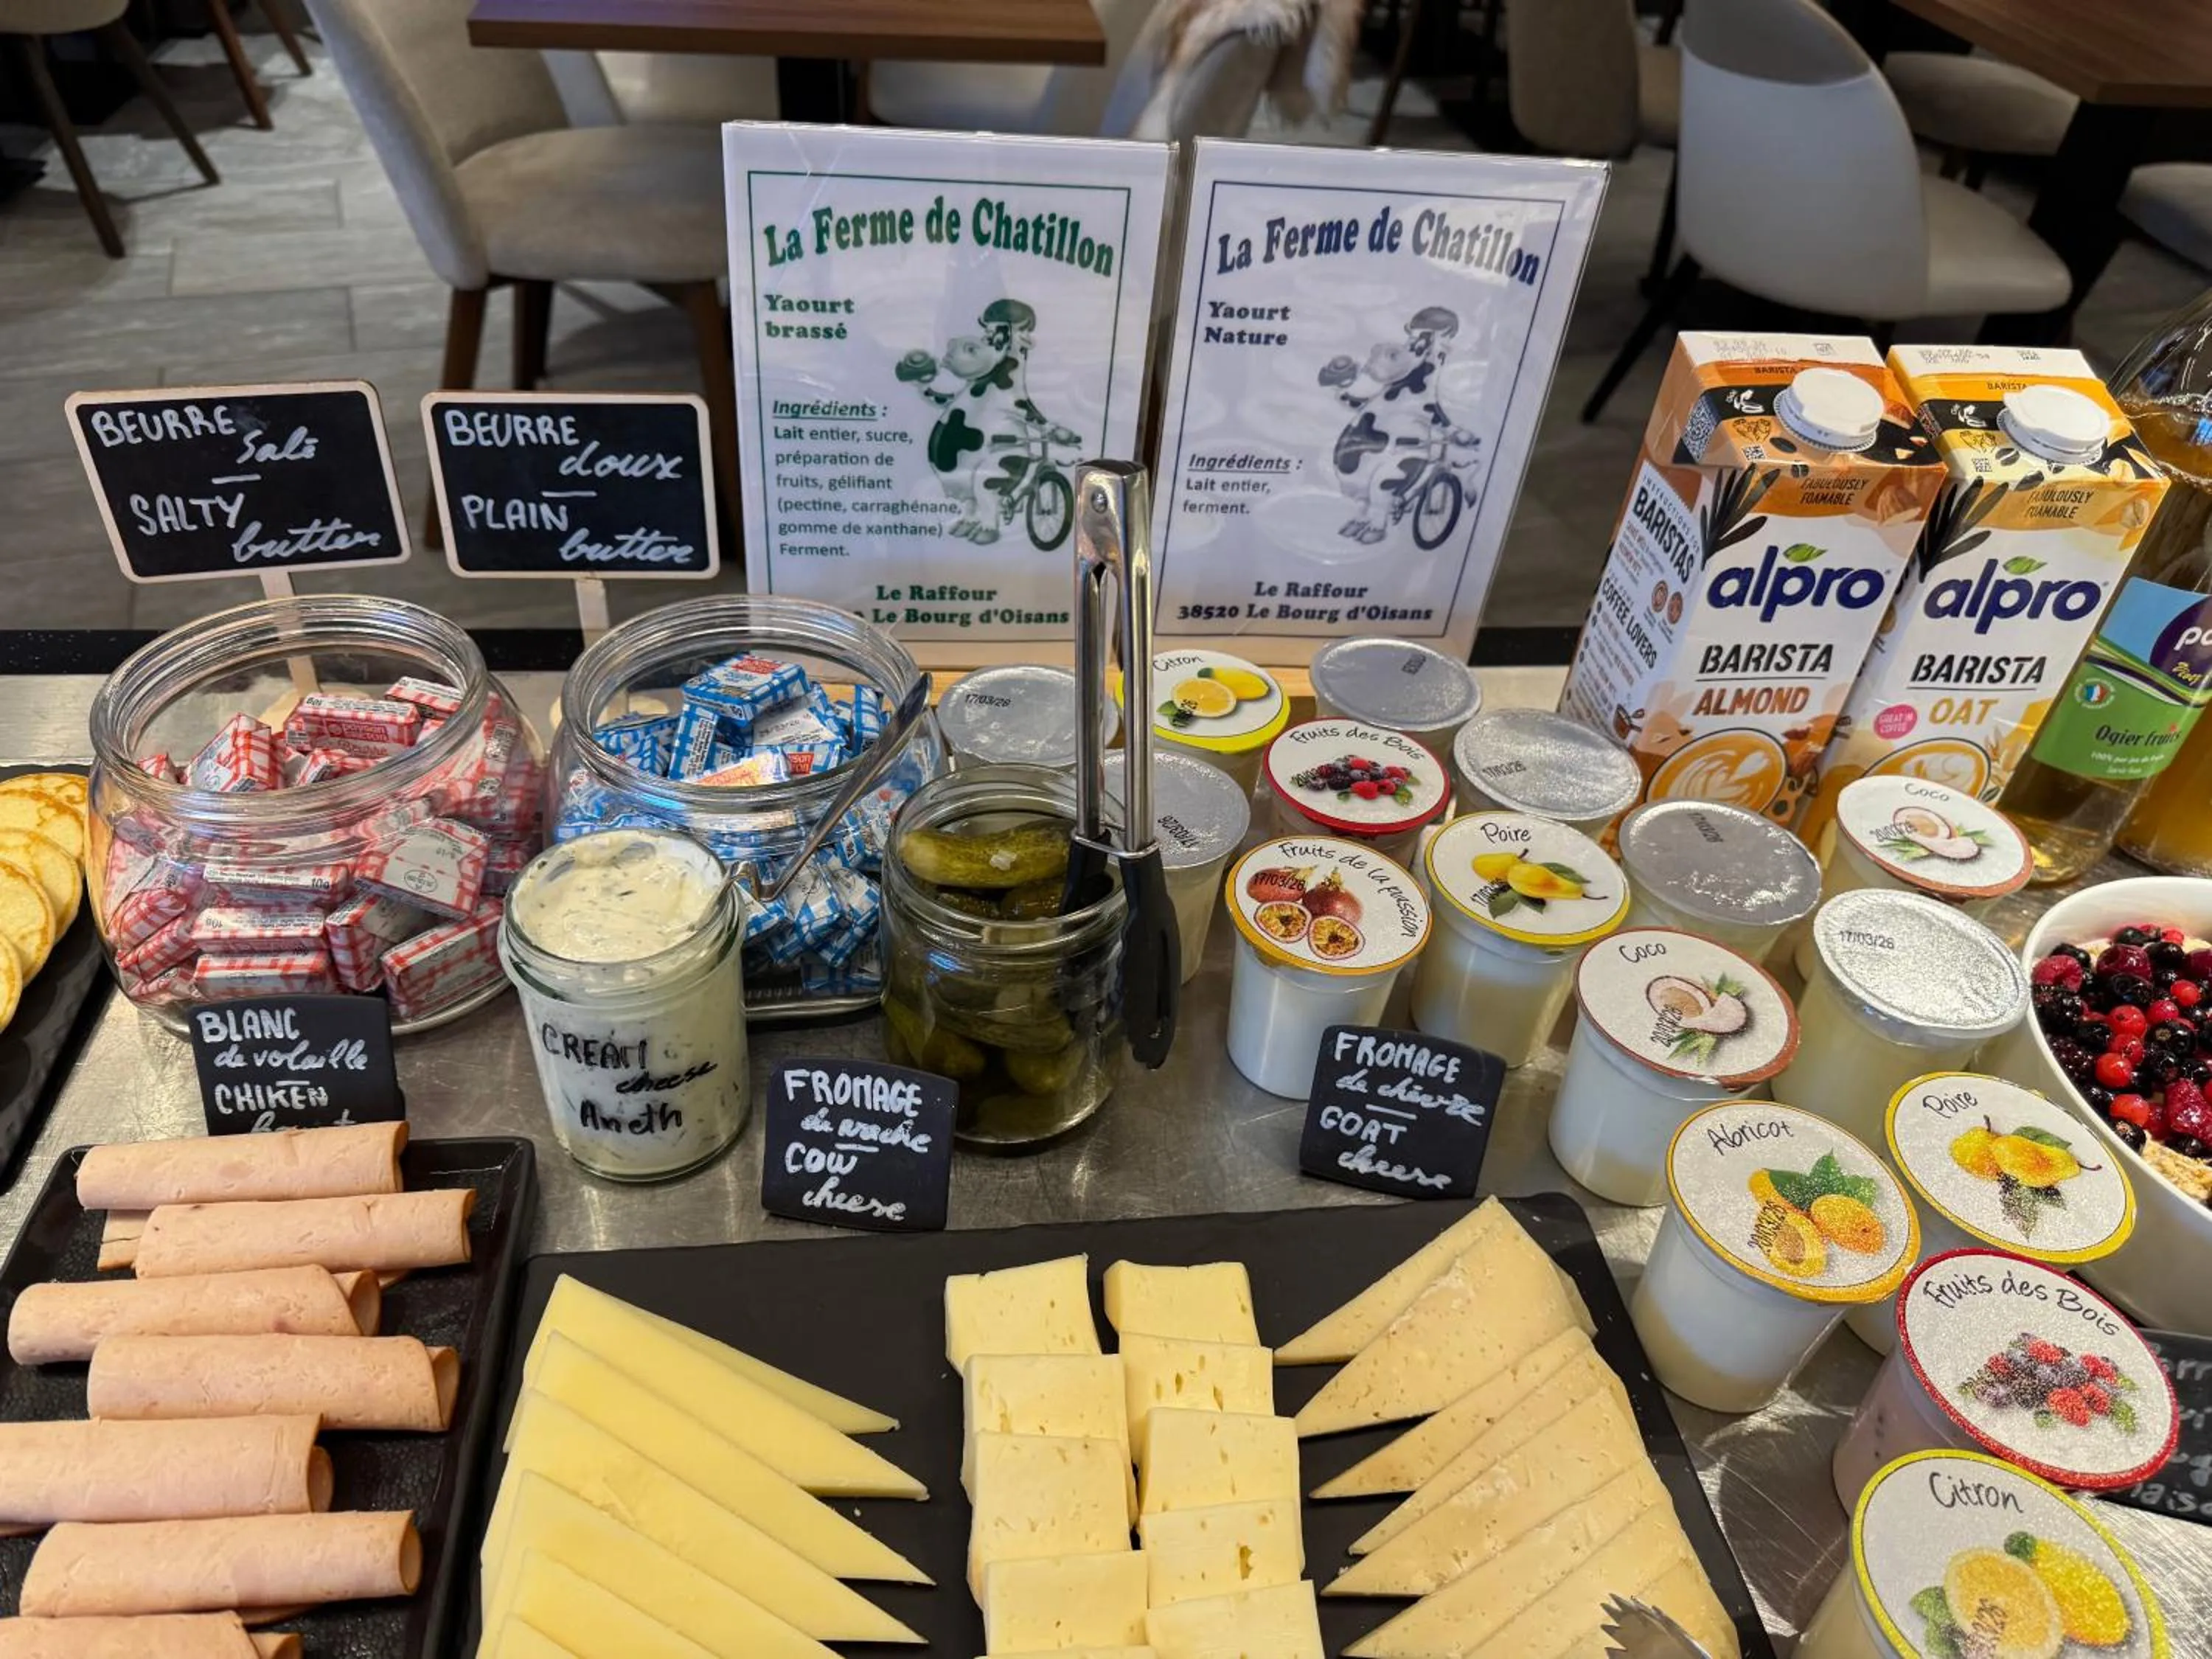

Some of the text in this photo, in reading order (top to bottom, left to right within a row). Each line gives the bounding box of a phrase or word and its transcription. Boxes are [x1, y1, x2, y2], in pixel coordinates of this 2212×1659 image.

[764, 196, 1113, 276] La Ferme de Chatillon
[1217, 206, 1540, 288] La Ferme de Chatillon
[765, 294, 855, 314] Yaourt
[1208, 301, 1290, 321] Yaourt
[765, 321, 849, 340] brassé
[1204, 327, 1288, 347] Nature
[92, 405, 237, 445] BEURRE
[772, 400, 877, 418] Ingrédients
[445, 410, 580, 445] BEURRE
[773, 427, 914, 445] Lait entier, sucre,
[560, 442, 686, 480] doux
[775, 451, 894, 468] préparation de
[1187, 453, 1291, 472] Ingrédients
[776, 474, 892, 492] fruits, gélifiant
[1186, 478, 1273, 495] Lait entier,
[131, 493, 246, 535] SALTY
[462, 495, 570, 532] PLAIN
[777, 497, 962, 518] (pectine, carraghénane,
[1182, 498, 1251, 515] ferment.
[232, 520, 383, 563] butter
[560, 527, 694, 563] butter
[778, 521, 944, 538] gomme de xanthane)
[1632, 486, 1694, 585] BARISTAS
[779, 543, 850, 557] Ferment.
[876, 585, 997, 602] Le Raffour
[1254, 582, 1368, 599] Le Raffour
[1705, 545, 1887, 622] alpro
[1923, 558, 2103, 634] alpro
[872, 609, 898, 625] Le
[905, 609, 974, 627] Bourg
[978, 609, 1069, 626] d'Oisans
[1177, 604, 1433, 624] 38520 Le Bourg d'Oisans
[1625, 615, 1658, 670] LOVERS
[1698, 643, 1834, 674] BARISTA
[1910, 653, 2048, 685] BARISTA
[1693, 686, 1812, 716] ALMOND
[1929, 697, 2000, 726] OAT
[1289, 725, 1427, 762] Fruits des Bois
[1904, 782, 1950, 803] Coco
[1480, 823, 1532, 843] Poire
[1278, 843, 1419, 939] Fruits de la passion
[1618, 940, 1669, 964] Coco
[1839, 930, 1895, 950] 17/03/26
[195, 1007, 302, 1043] BLANC
[213, 1037, 369, 1071] de volaille
[1333, 1032, 1462, 1084] FROMAGE
[616, 1060, 719, 1094] cheese
[1335, 1068, 1369, 1094] de
[214, 1082, 330, 1115] CHIKEN
[784, 1069, 923, 1118] FROMAGE
[1921, 1091, 1979, 1120] Poire
[580, 1099, 684, 1135] Aneth
[801, 1107, 835, 1133] de
[1319, 1105, 1408, 1144] GOAT
[1706, 1120, 1795, 1157] Abricot
[785, 1141, 858, 1176] COW
[1338, 1144, 1453, 1191] cheese
[801, 1175, 907, 1222] cheese
[1922, 1269, 2121, 1338] Fruits des Bois
[1927, 1471, 2025, 1514] Citron
